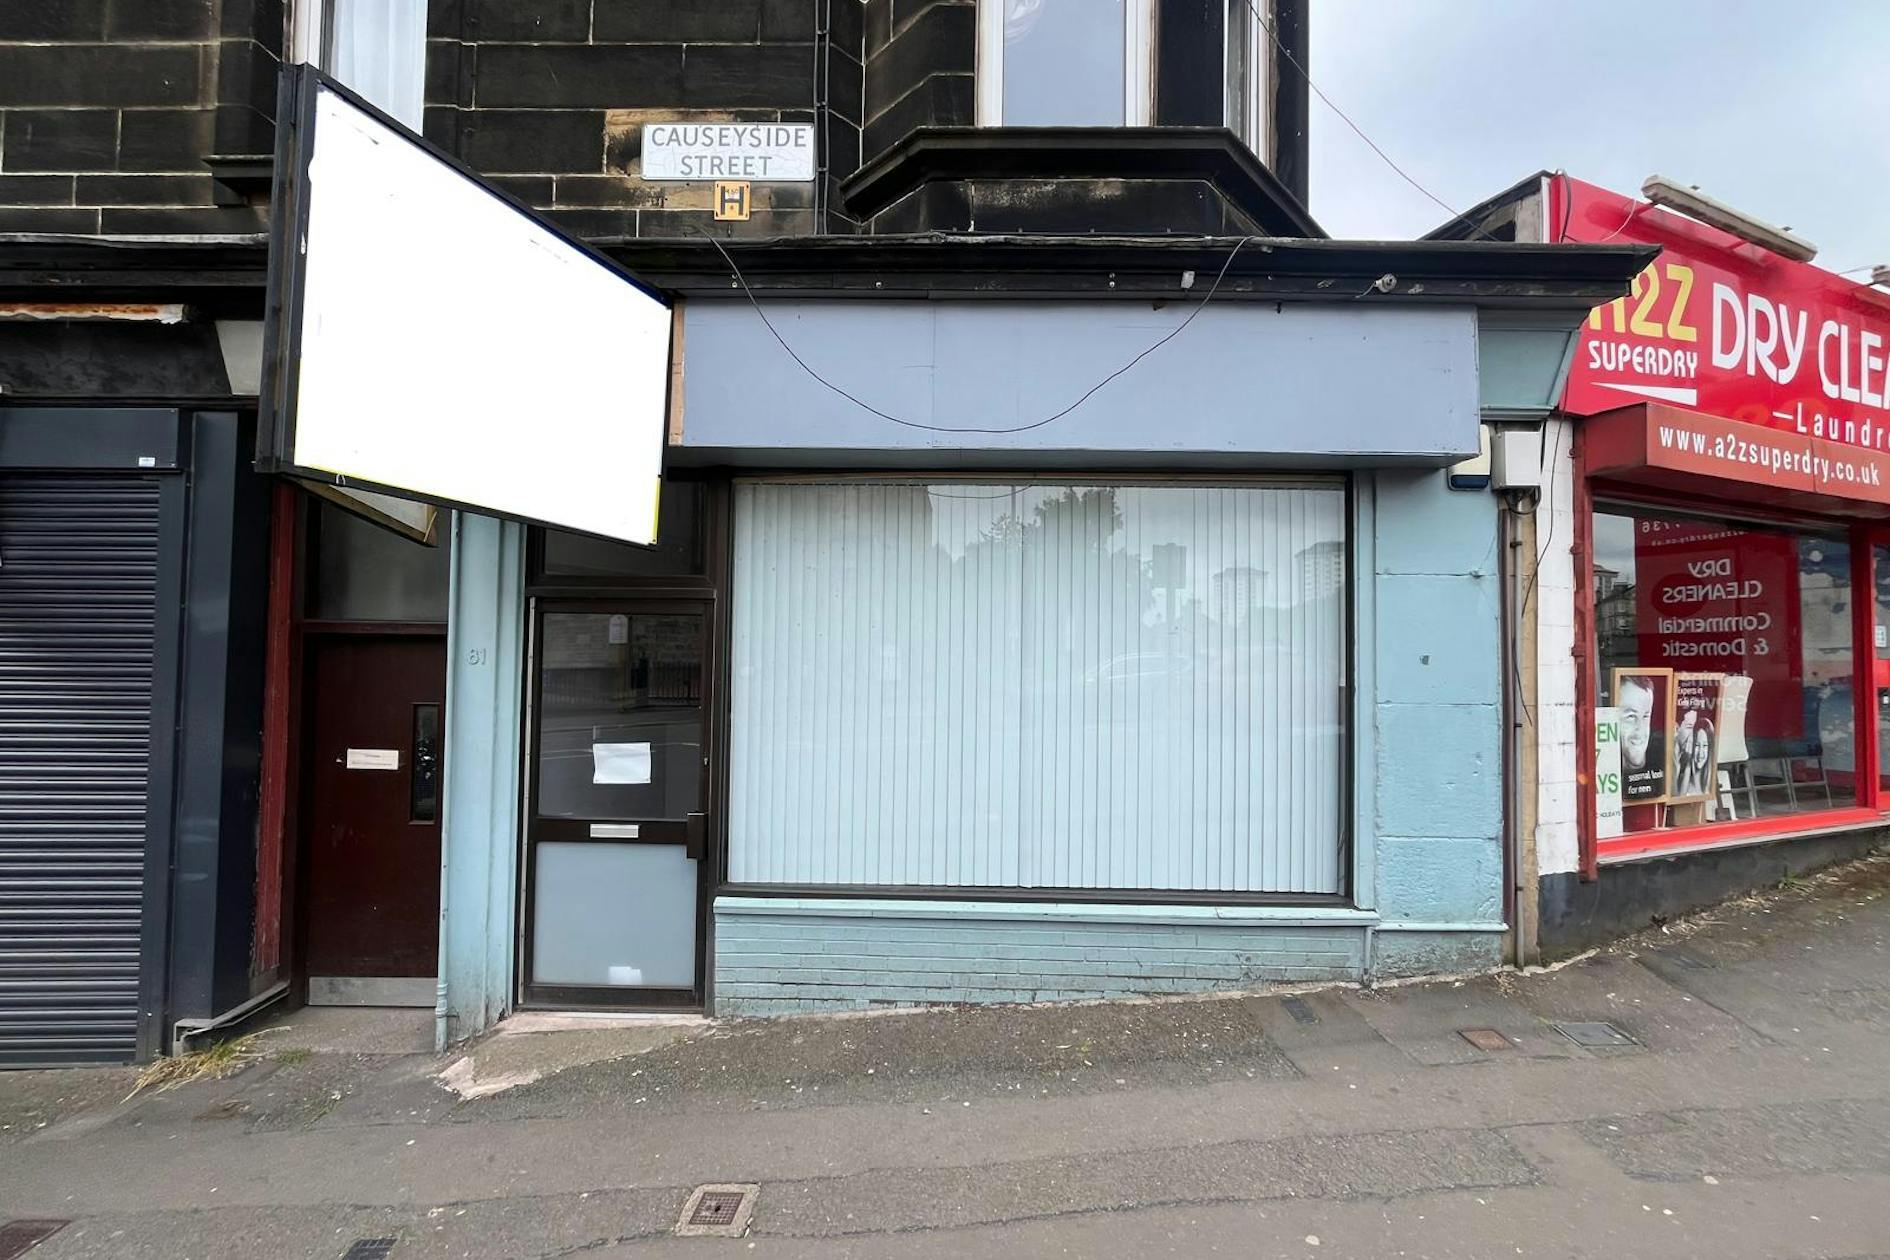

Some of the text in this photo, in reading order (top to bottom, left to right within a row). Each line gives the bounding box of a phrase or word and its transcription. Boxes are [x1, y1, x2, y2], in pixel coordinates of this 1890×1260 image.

[651, 127, 807, 147] CAUSEYSIDE
[680, 155, 772, 176] STREET
[720, 186, 745, 215] H
[1712, 282, 1808, 385] DRY
[1588, 340, 1698, 378] SUPERDRY
[1796, 402, 1890, 450] Laundr
[1659, 426, 1880, 485] www.a2zsuperdry.co.uk
[1597, 722, 1618, 742] EN
[1596, 773, 1618, 794] YS
